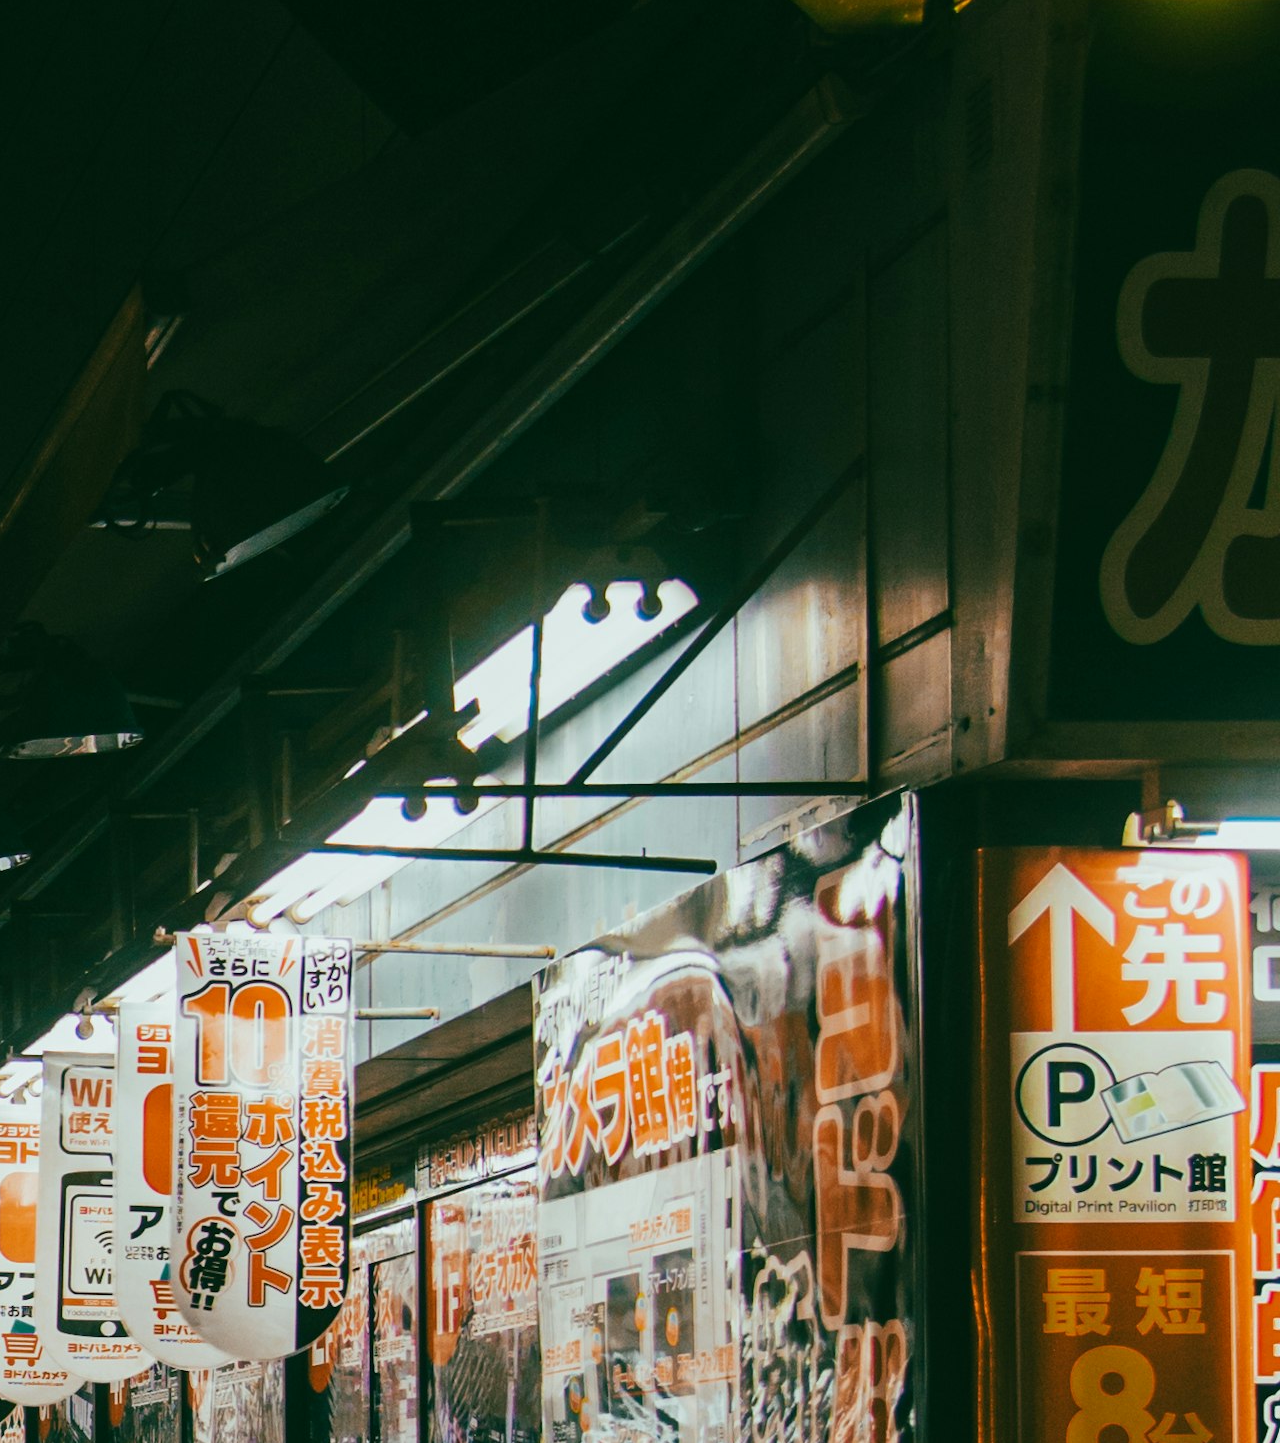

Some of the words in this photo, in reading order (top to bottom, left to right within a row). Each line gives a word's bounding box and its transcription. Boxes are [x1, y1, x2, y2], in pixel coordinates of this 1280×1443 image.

[208, 957, 270, 977] さらに
[1120, 922, 1229, 1027] 先
[1047, 1060, 1097, 1127] P
[298, 1014, 349, 1310] 消費税込み表示
[1025, 1152, 1228, 1194] プリント館
[242, 1093, 297, 1308] ポイント
[1024, 1198, 1072, 1216] Digital
[1076, 1198, 1124, 1214] Print
[1128, 1197, 1178, 1214] Pavilion
[1042, 1267, 1207, 1337] 最短
[3, 1369, 69, 1380] ヨドバシカメラ
[67, 1342, 143, 1354] ヨドバシカメラ
